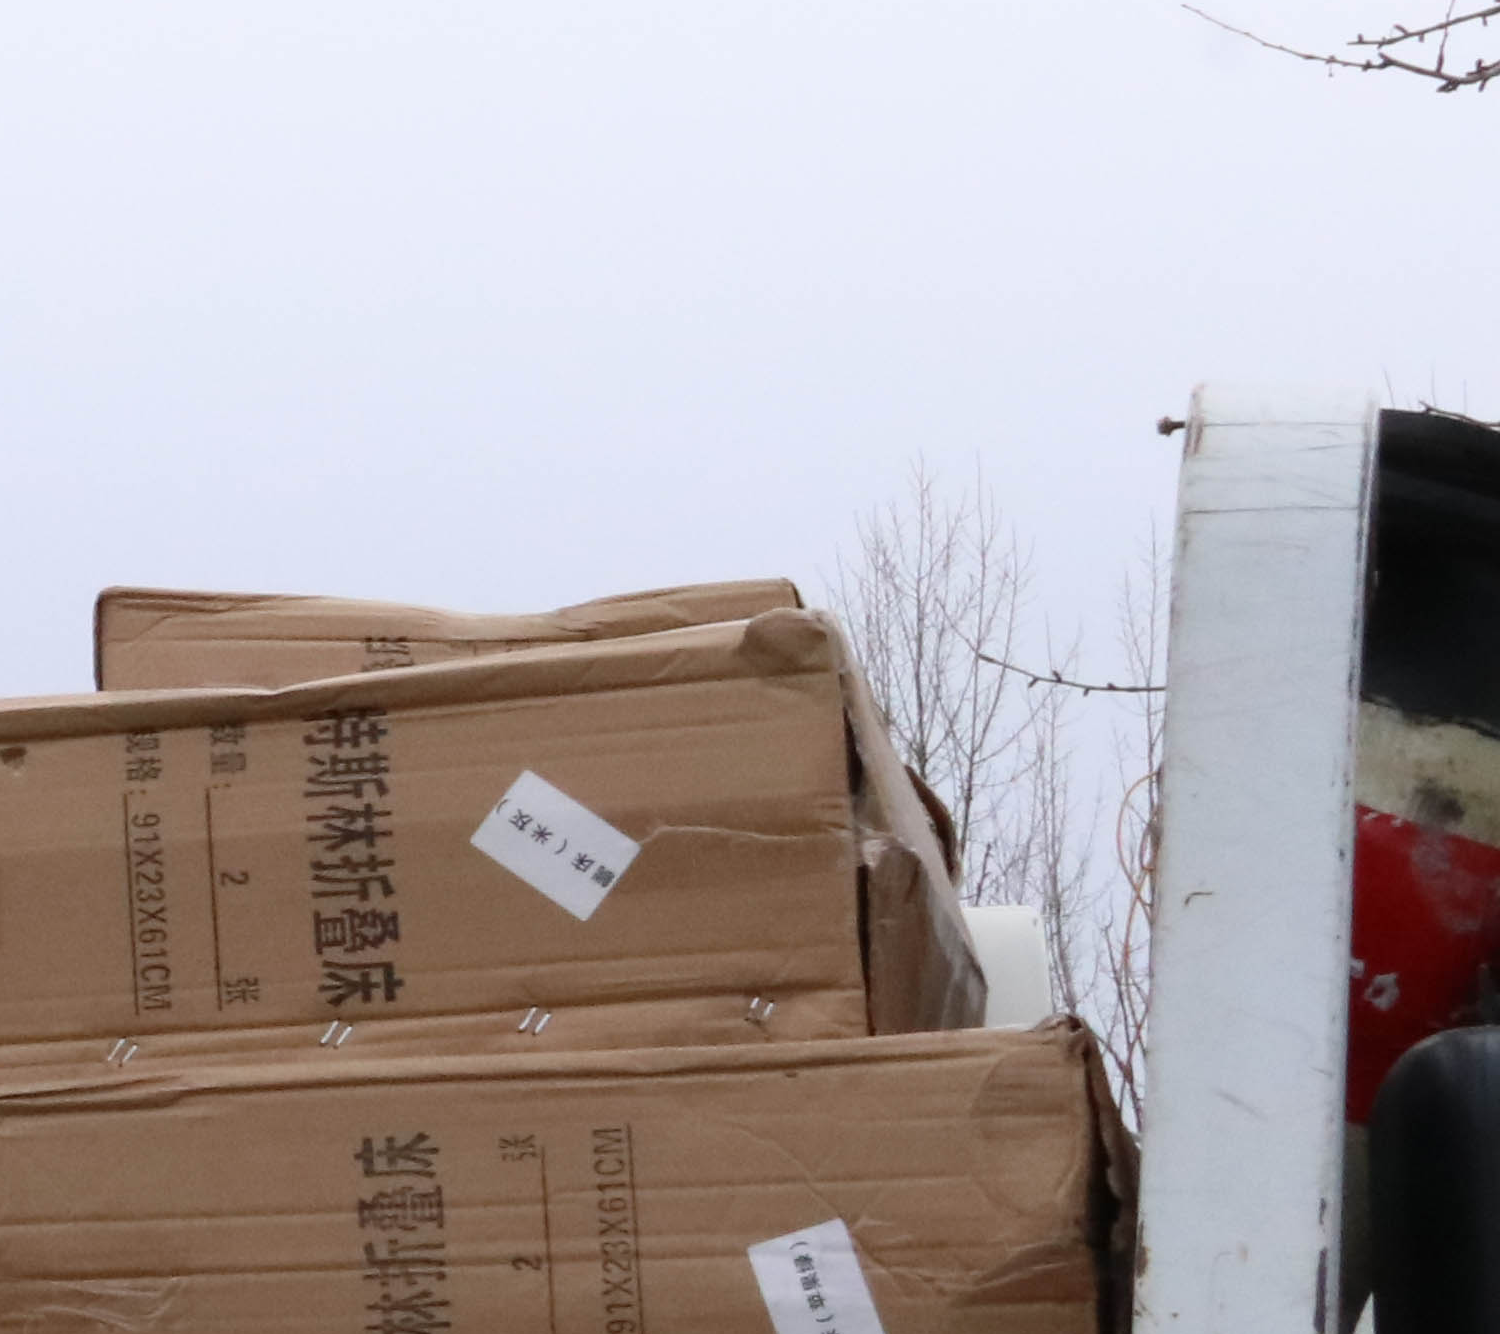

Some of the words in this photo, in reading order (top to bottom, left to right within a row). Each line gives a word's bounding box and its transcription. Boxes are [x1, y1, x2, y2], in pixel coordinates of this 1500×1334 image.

[303, 707, 405, 1008] 特斯林折叠床
[220, 871, 250, 888] 2
[132, 813, 172, 1011] 91X23X61CM
[224, 977, 260, 1005] 张
[499, 1134, 538, 1161] 张
[510, 1255, 542, 1271] 2
